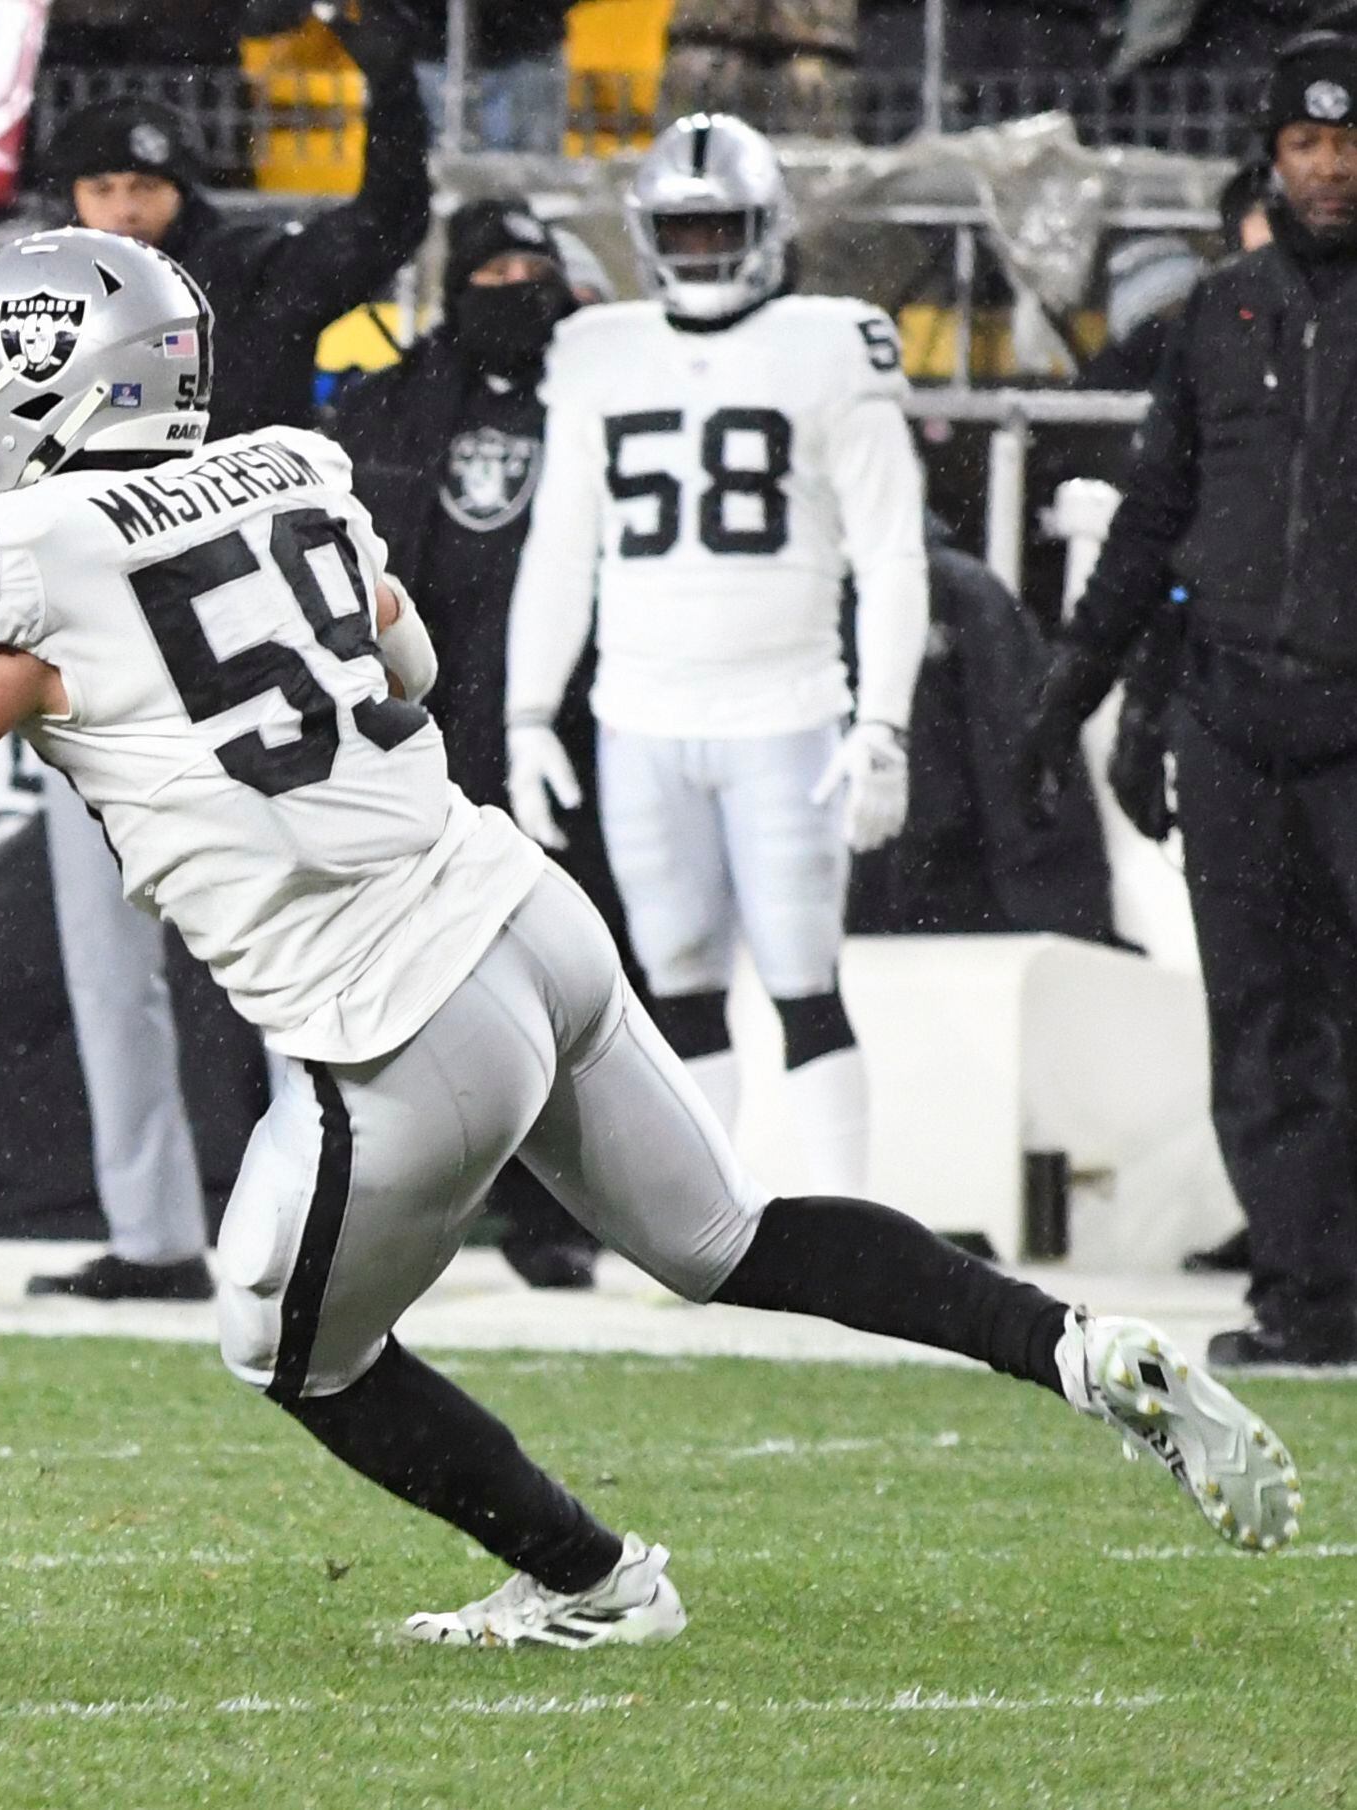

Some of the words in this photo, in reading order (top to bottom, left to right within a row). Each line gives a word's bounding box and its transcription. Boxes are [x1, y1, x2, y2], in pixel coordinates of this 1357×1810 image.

[7, 299, 78, 314] RAIDERS
[86, 440, 325, 545] MASTERSON
[604, 406, 792, 558] 58
[128, 508, 430, 797] 59
